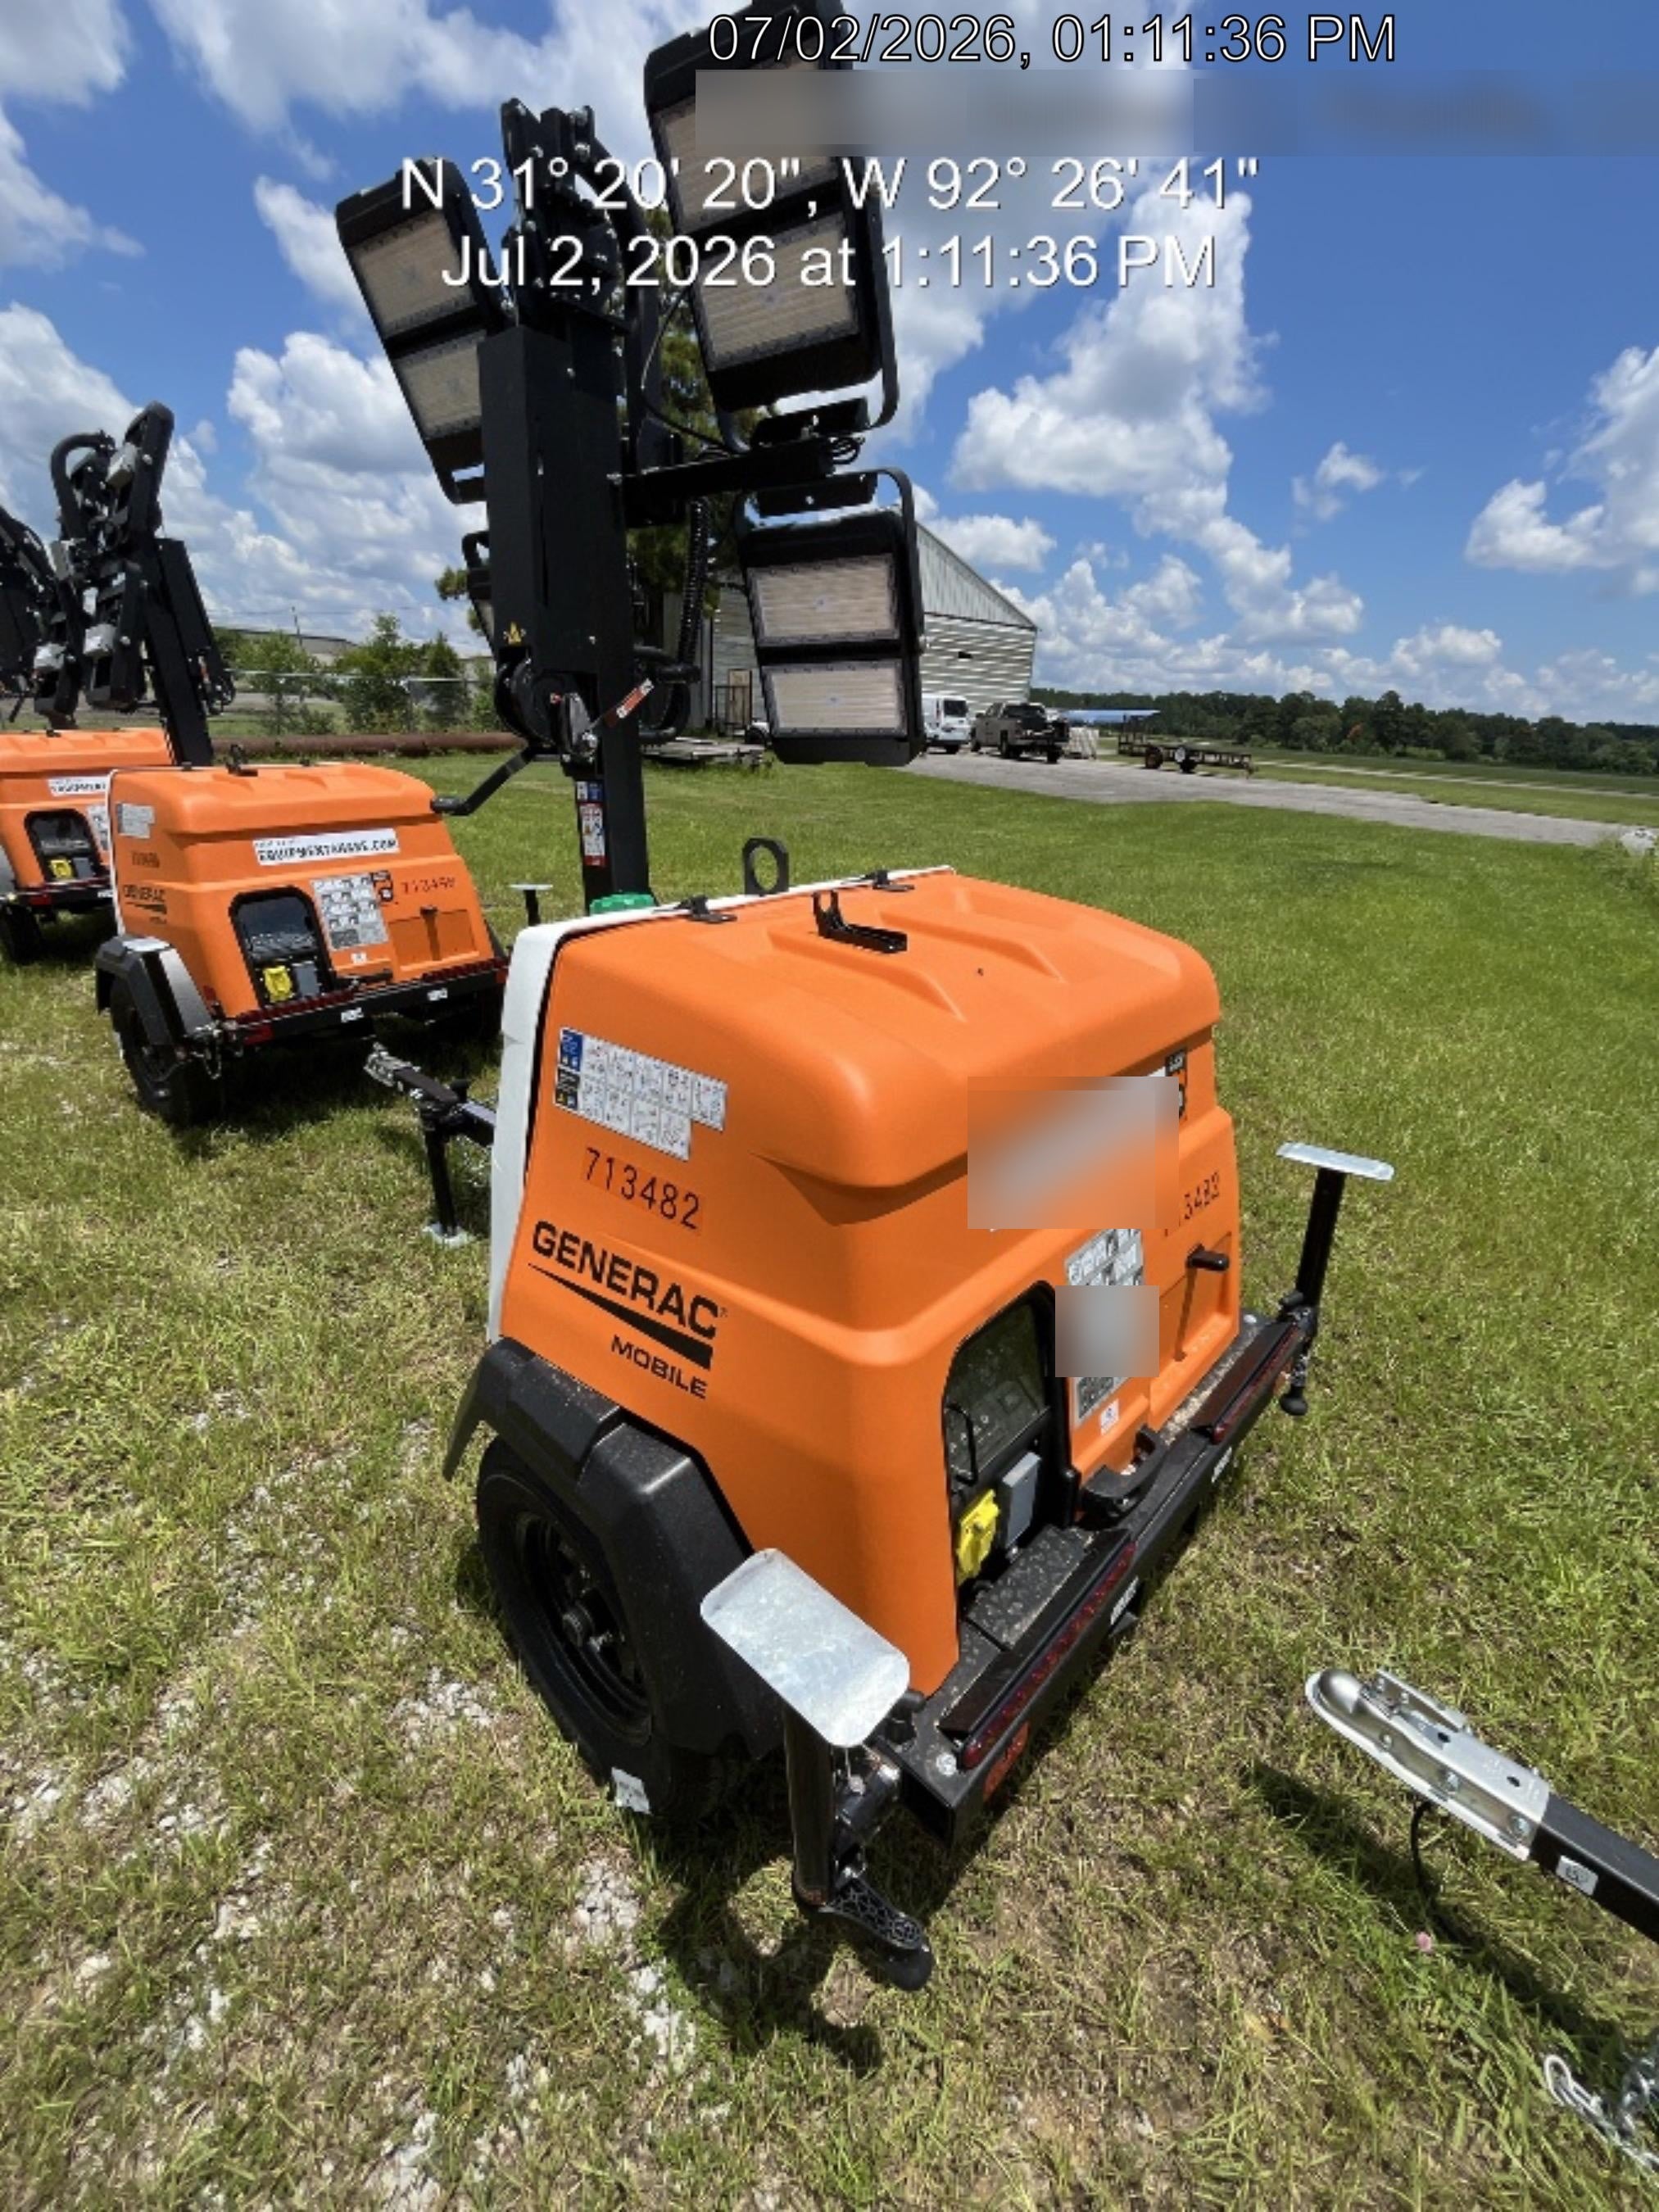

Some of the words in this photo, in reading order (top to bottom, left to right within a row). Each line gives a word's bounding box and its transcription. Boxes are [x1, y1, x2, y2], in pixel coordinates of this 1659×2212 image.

[586, 1147, 700, 1230] 713482
[533, 1220, 718, 1340] GENERAC
[611, 1334, 708, 1399] MOBILE
